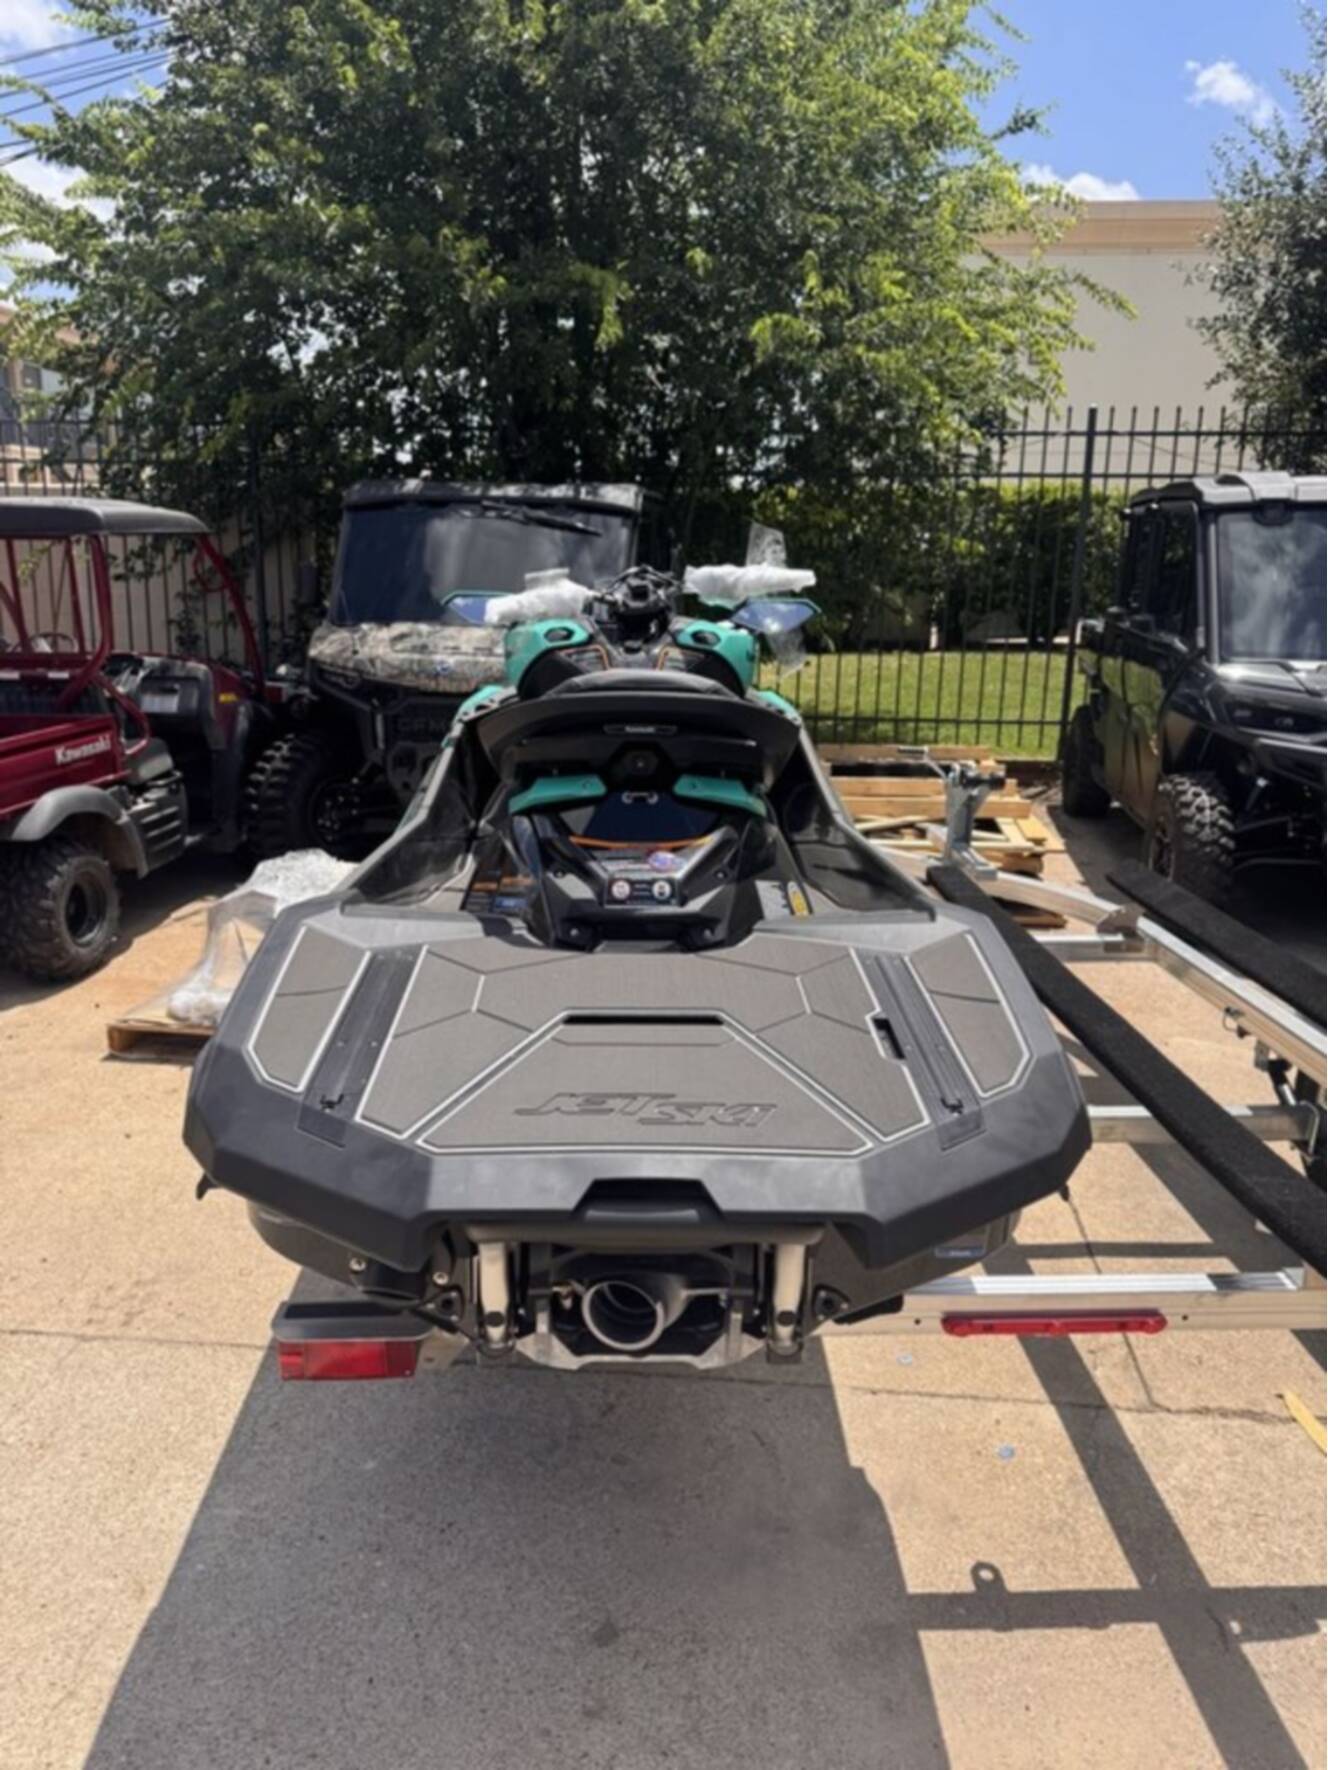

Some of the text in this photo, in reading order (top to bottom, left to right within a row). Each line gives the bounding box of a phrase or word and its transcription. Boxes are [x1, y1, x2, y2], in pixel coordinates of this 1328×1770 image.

[55, 735, 111, 765] Kawasaki
[514, 1092, 778, 1126] JET SKI
